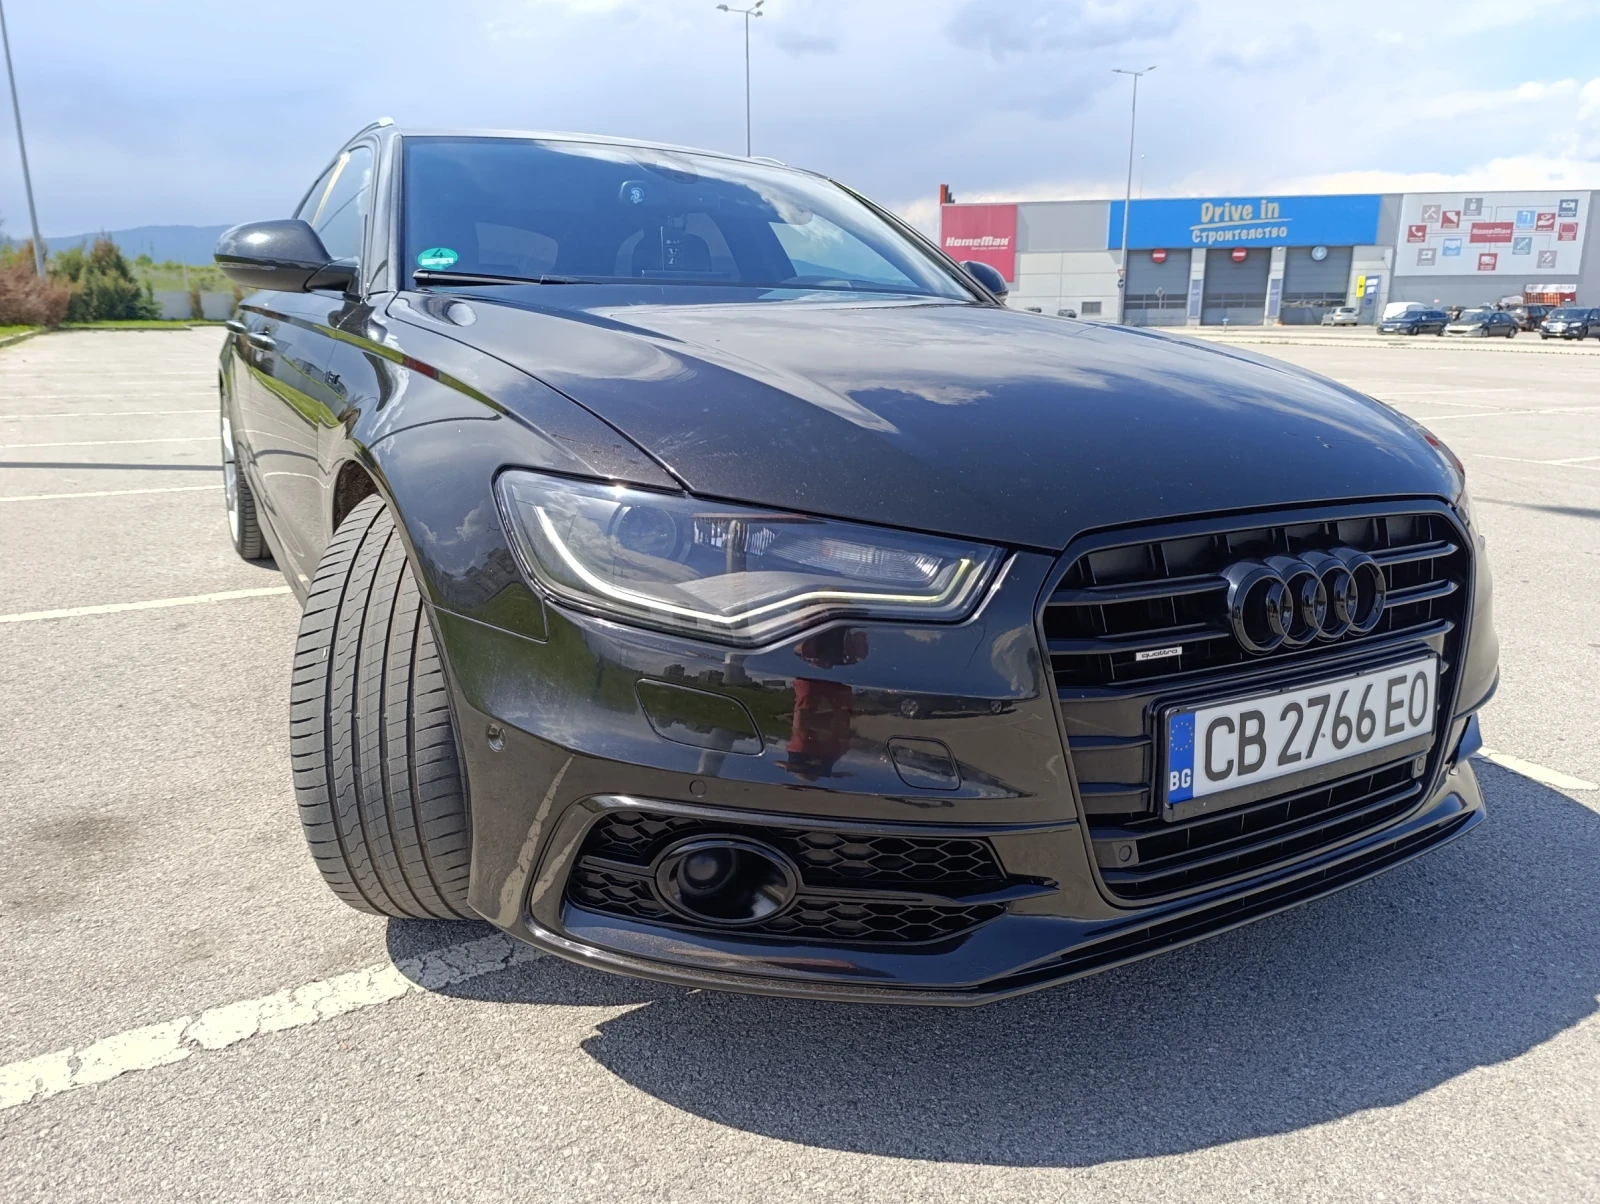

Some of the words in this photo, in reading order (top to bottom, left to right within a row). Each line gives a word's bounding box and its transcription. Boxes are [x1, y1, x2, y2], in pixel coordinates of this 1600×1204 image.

[1201, 202, 1253, 223] Drive
[1260, 200, 1279, 219] in
[945, 236, 1011, 247] HomeMax
[1191, 227, 1288, 245] Строителство
[432, 248, 444, 258] 4
[1141, 649, 1178, 659] quattro
[1204, 709, 1267, 782] CB
[1277, 684, 1377, 767] 2766
[1169, 770, 1192, 791] BG
